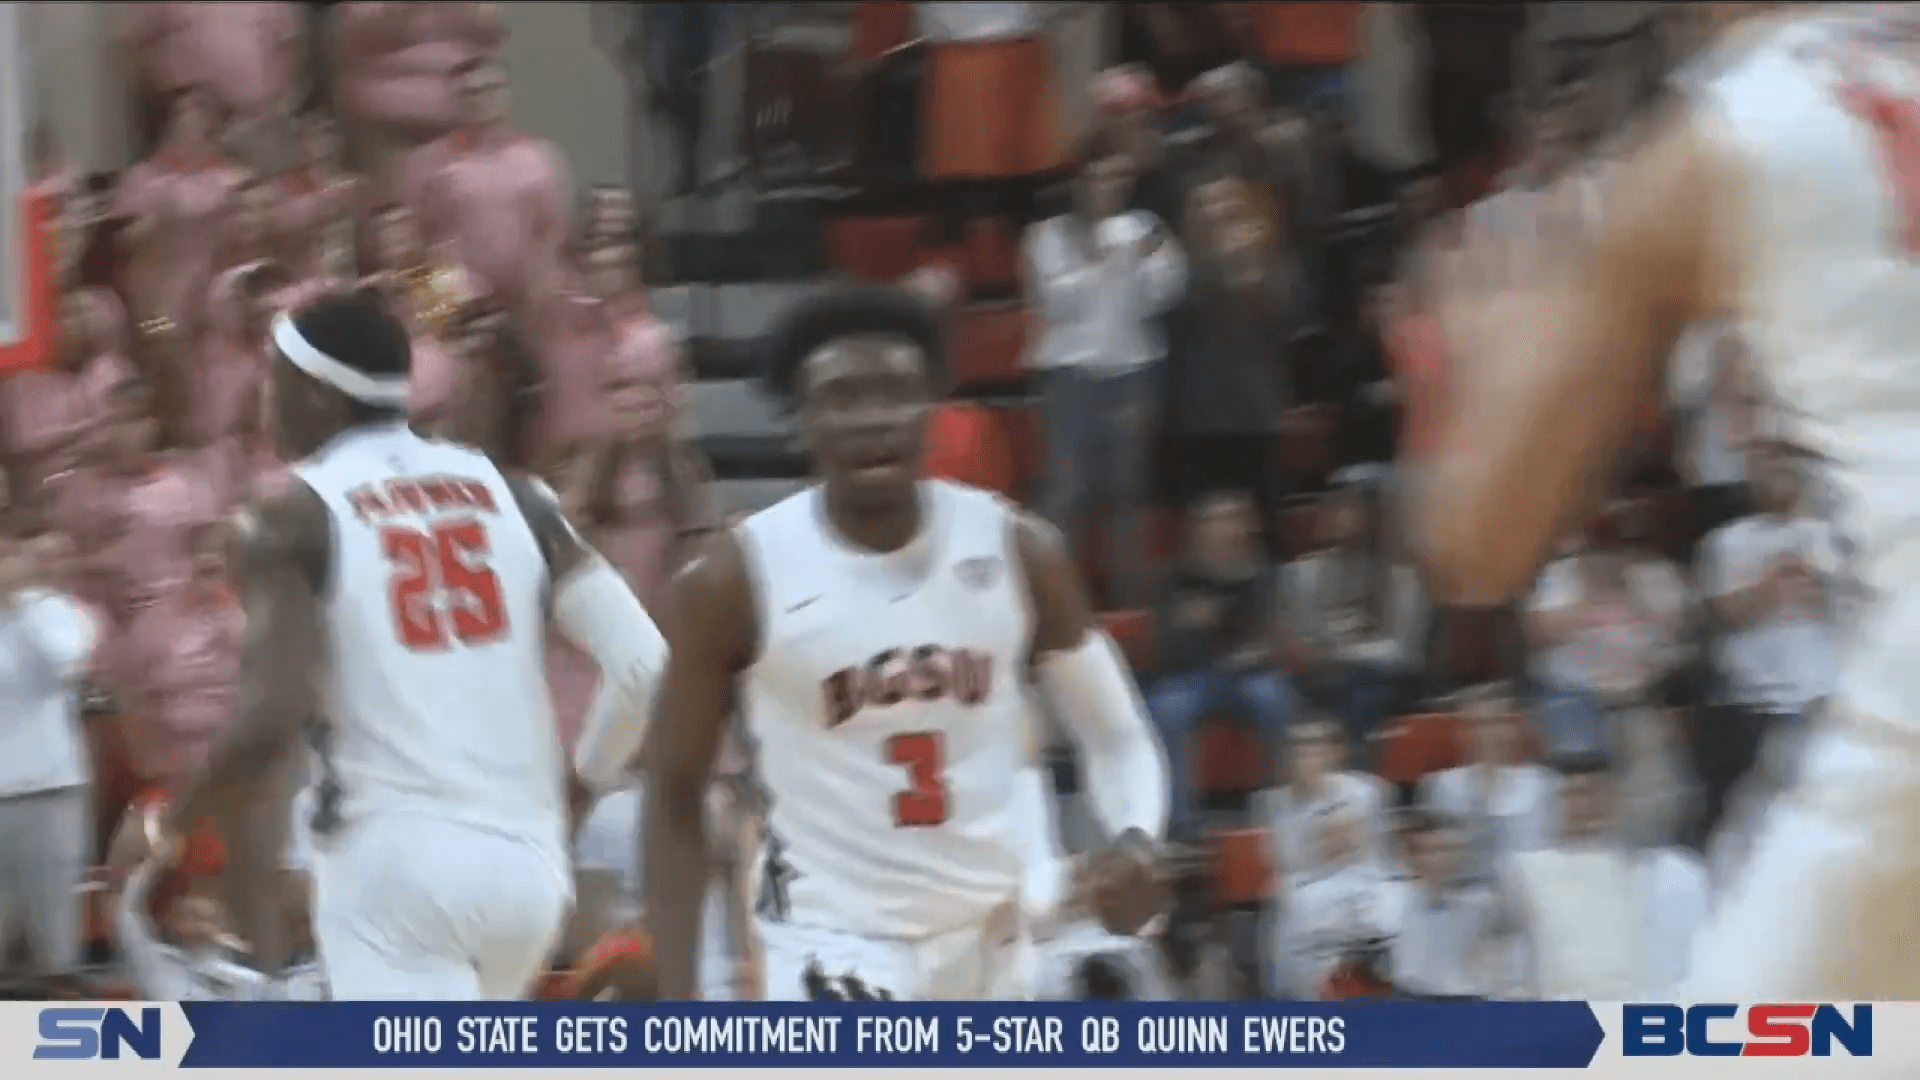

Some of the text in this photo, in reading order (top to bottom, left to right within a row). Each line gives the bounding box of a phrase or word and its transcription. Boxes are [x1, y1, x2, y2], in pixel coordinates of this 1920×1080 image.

[380, 517, 511, 651] 25
[820, 644, 993, 729] BGSU
[885, 732, 951, 828] 3
